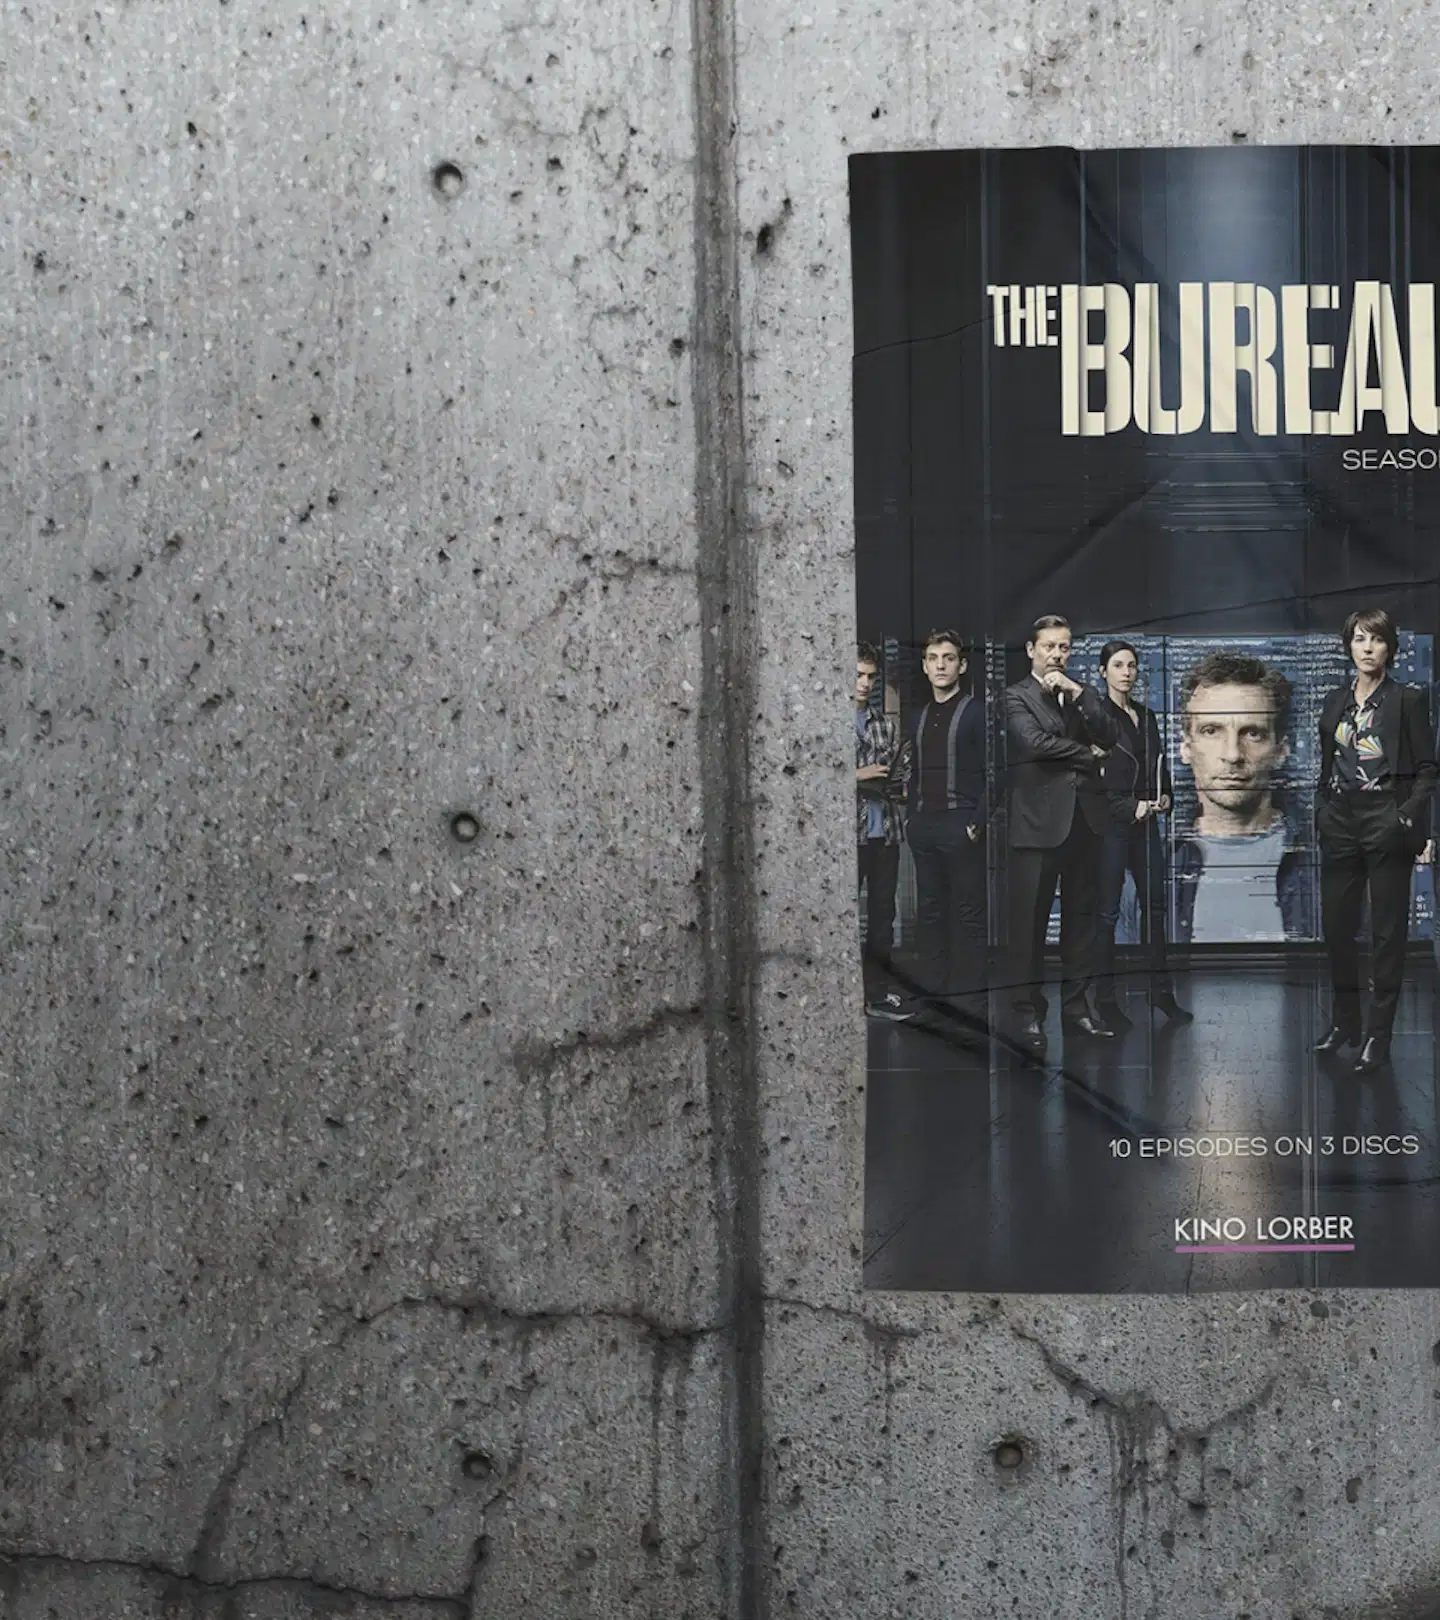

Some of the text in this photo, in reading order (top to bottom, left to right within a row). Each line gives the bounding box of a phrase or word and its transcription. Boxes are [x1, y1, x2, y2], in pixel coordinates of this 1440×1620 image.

[987, 284, 1058, 347] THE
[1109, 1135, 1420, 1158] 10 EPISODES ON 3 DISCS
[1175, 1217, 1355, 1242] KINO LORBER
